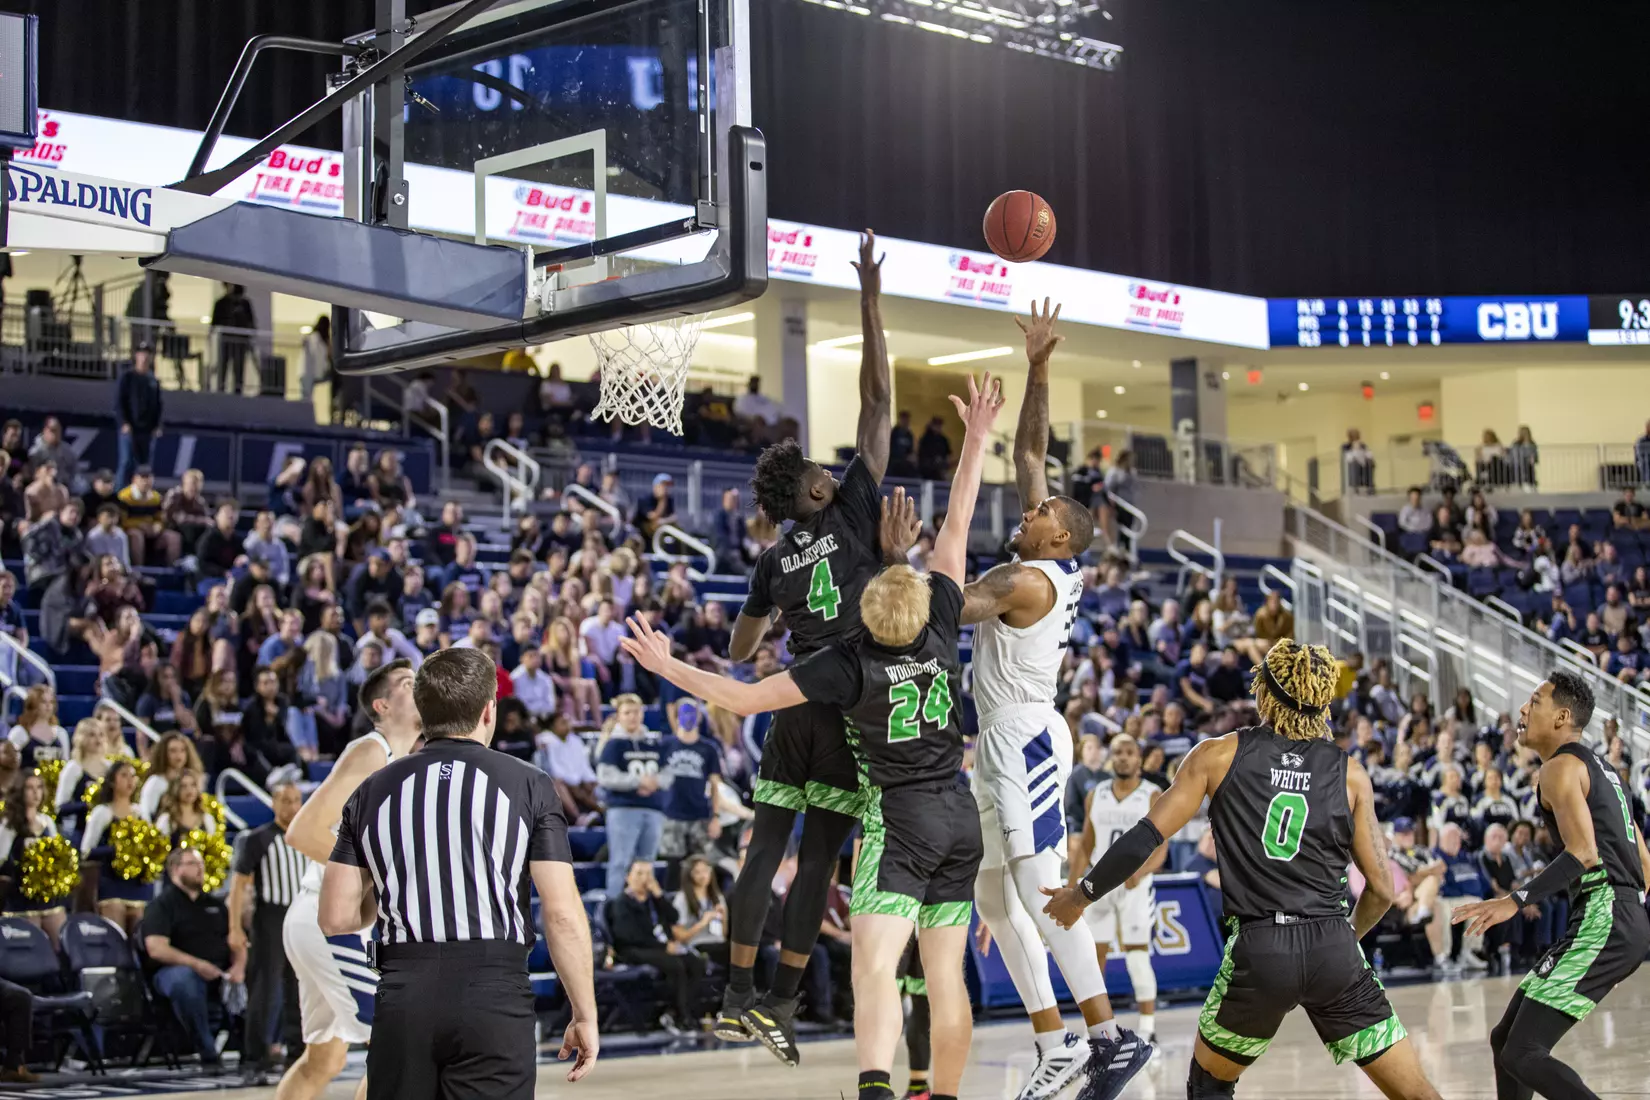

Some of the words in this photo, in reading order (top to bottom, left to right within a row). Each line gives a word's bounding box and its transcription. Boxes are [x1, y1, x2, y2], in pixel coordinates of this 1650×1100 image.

[1477, 301, 1559, 340] CBU
[807, 557, 841, 621] 4
[887, 669, 953, 744] 24
[1270, 767, 1312, 791] WHITE
[1261, 791, 1309, 862] 0
